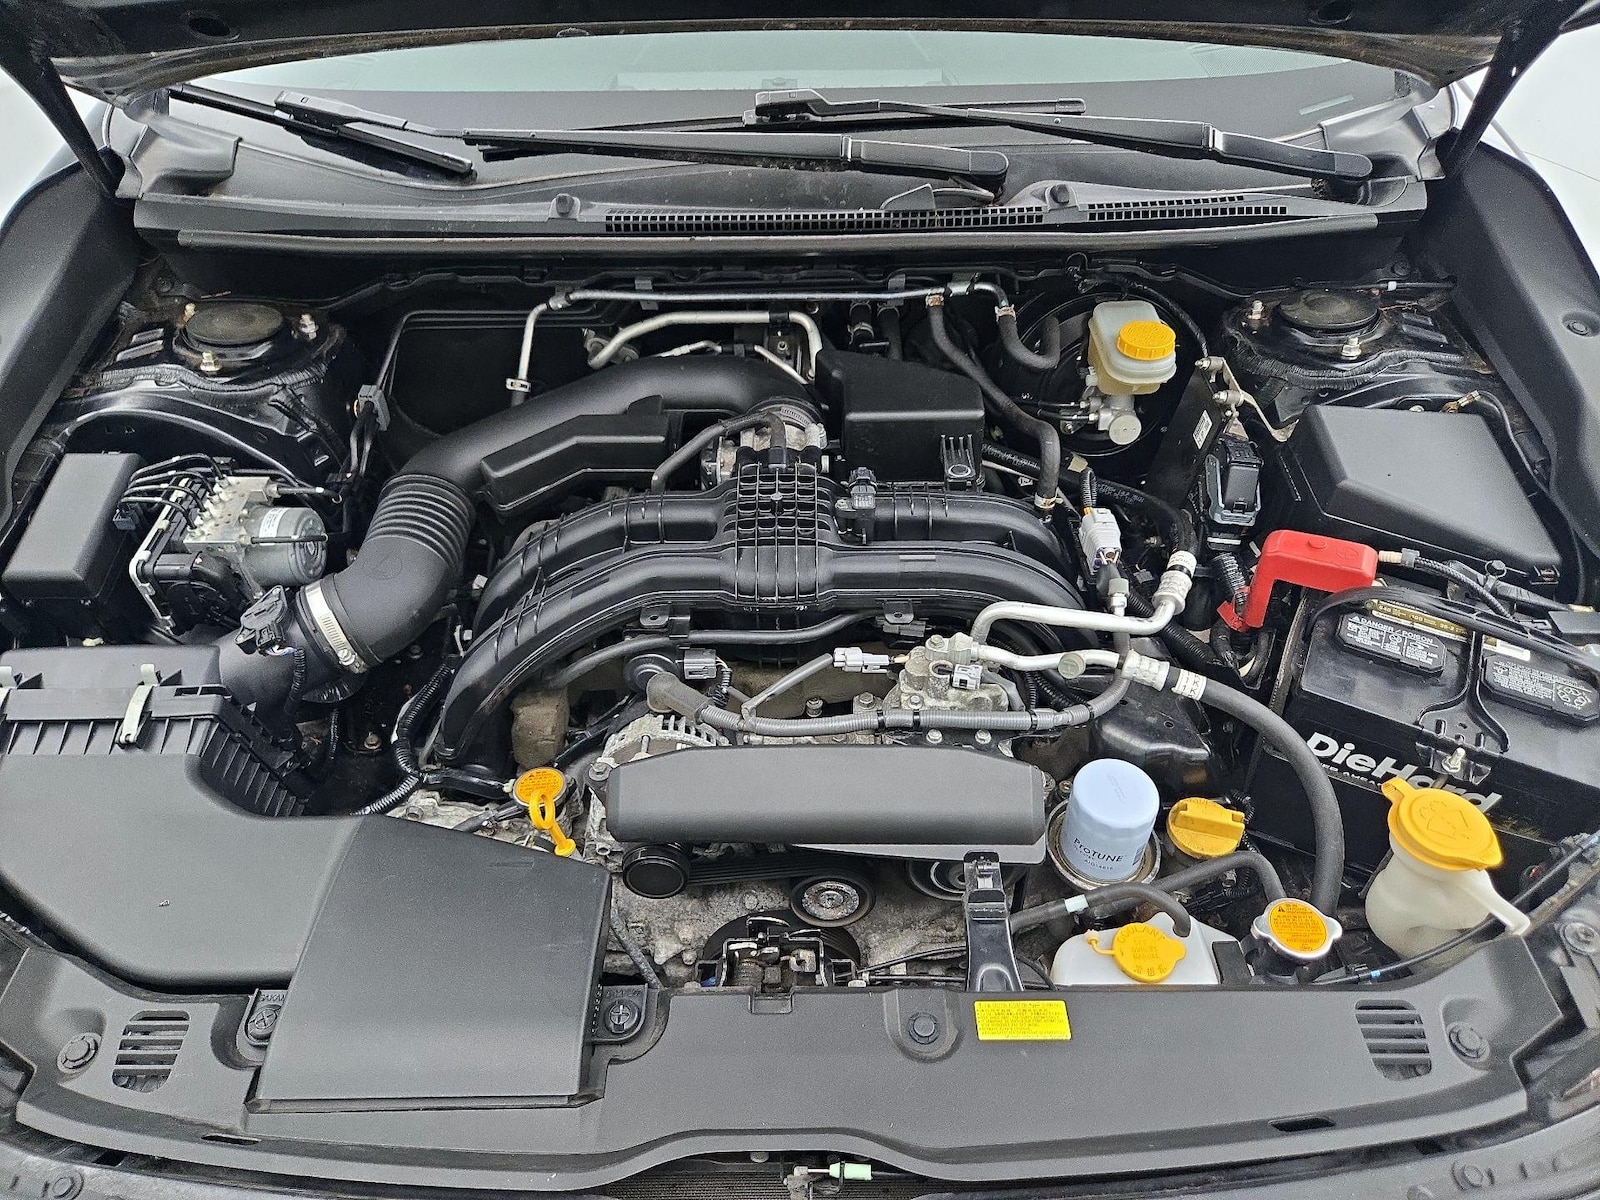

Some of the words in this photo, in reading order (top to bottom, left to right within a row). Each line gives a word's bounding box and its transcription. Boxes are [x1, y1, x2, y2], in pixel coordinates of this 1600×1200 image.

[1361, 617, 1394, 632] DANGER
[1402, 630, 1434, 644] POISON
[1306, 731, 1502, 813] DieHard
[1117, 925, 1166, 943] COOLANT
